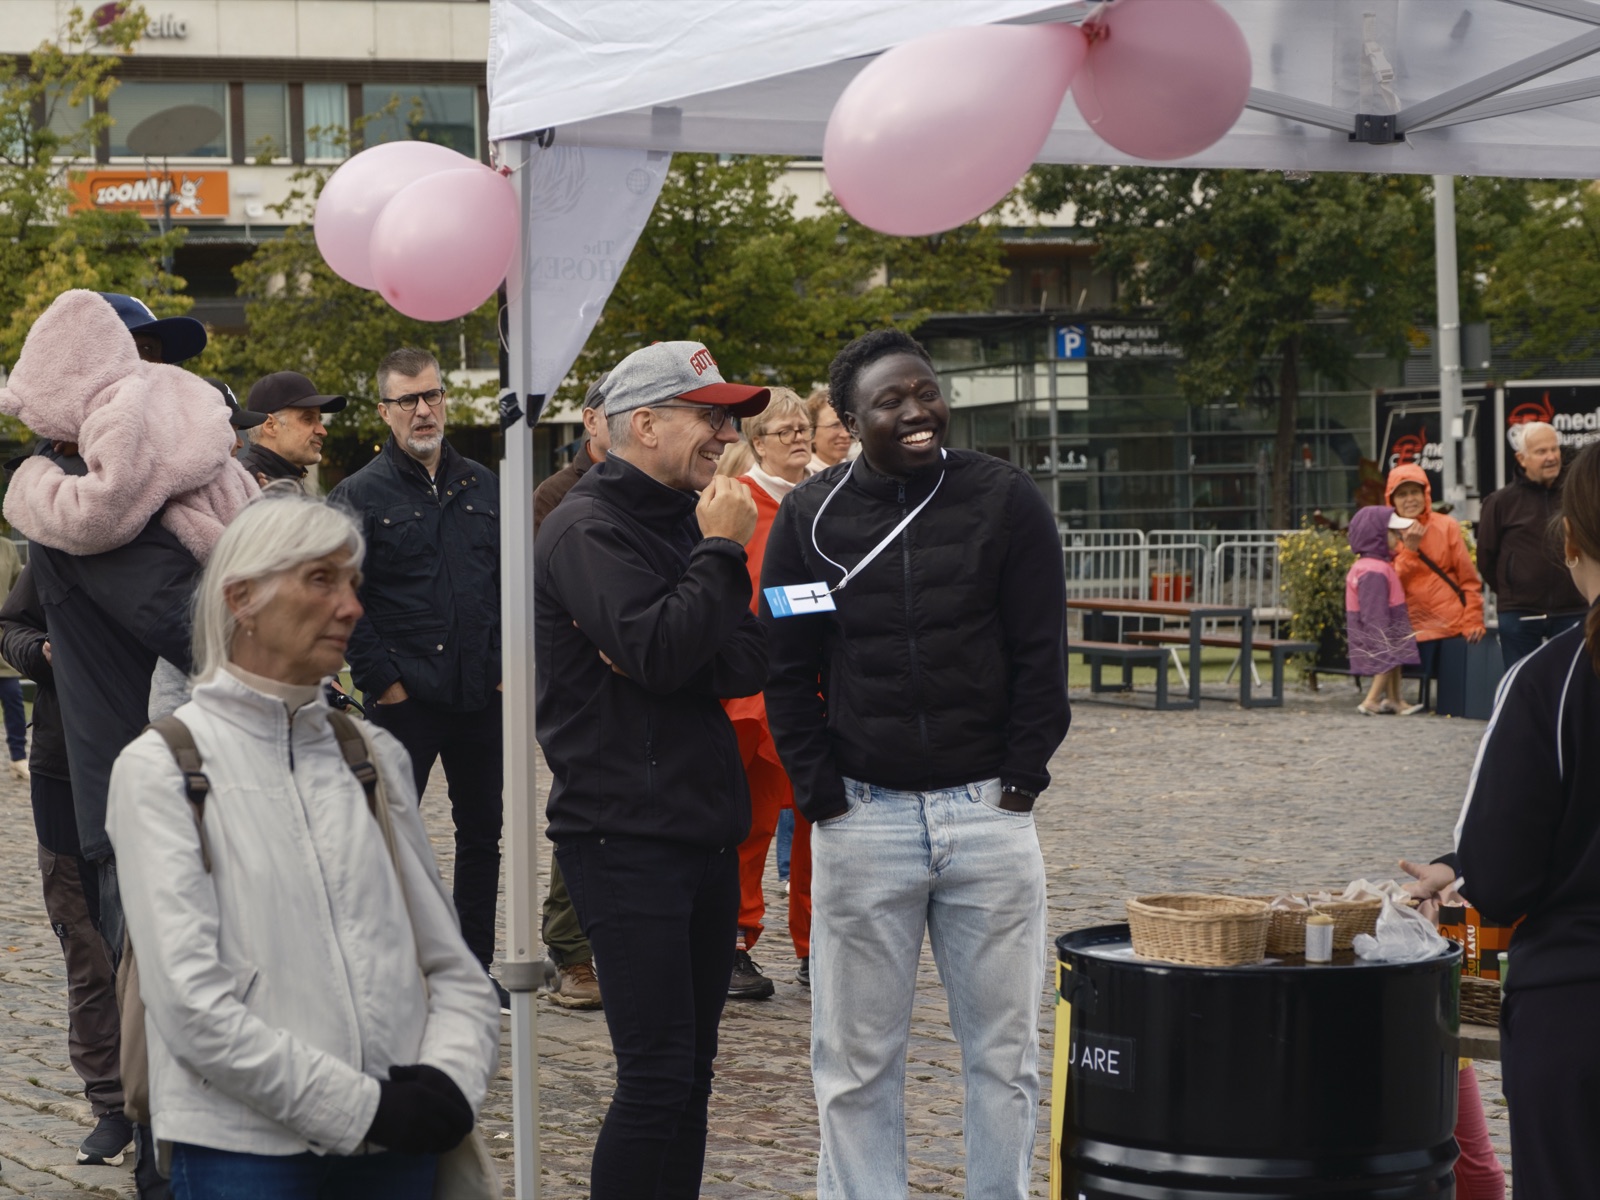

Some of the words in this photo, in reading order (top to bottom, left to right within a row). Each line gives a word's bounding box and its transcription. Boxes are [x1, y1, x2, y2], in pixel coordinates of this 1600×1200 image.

[144, 14, 188, 39] elia
[1467, 924, 1476, 958] LAKU
[1081, 1046, 1120, 1074] ARE
